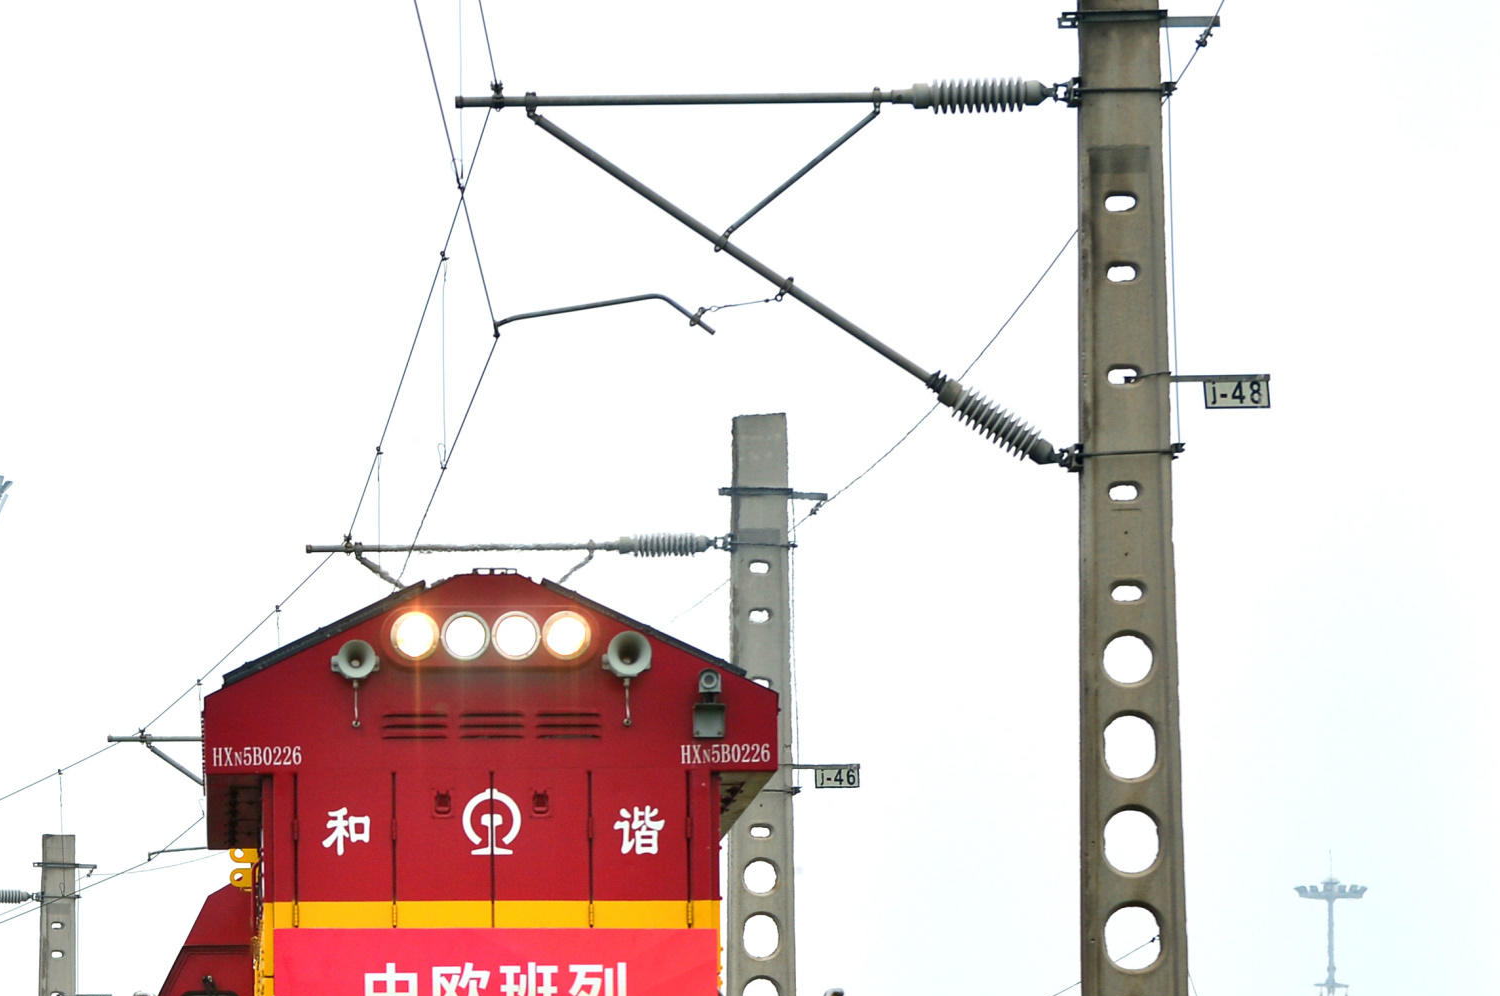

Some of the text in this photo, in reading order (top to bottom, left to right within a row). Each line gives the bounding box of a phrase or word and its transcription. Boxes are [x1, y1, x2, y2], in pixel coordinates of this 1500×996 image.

[1210, 381, 1262, 405] j-48
[820, 768, 856, 786] j-46
[322, 805, 666, 855] 和 谐
